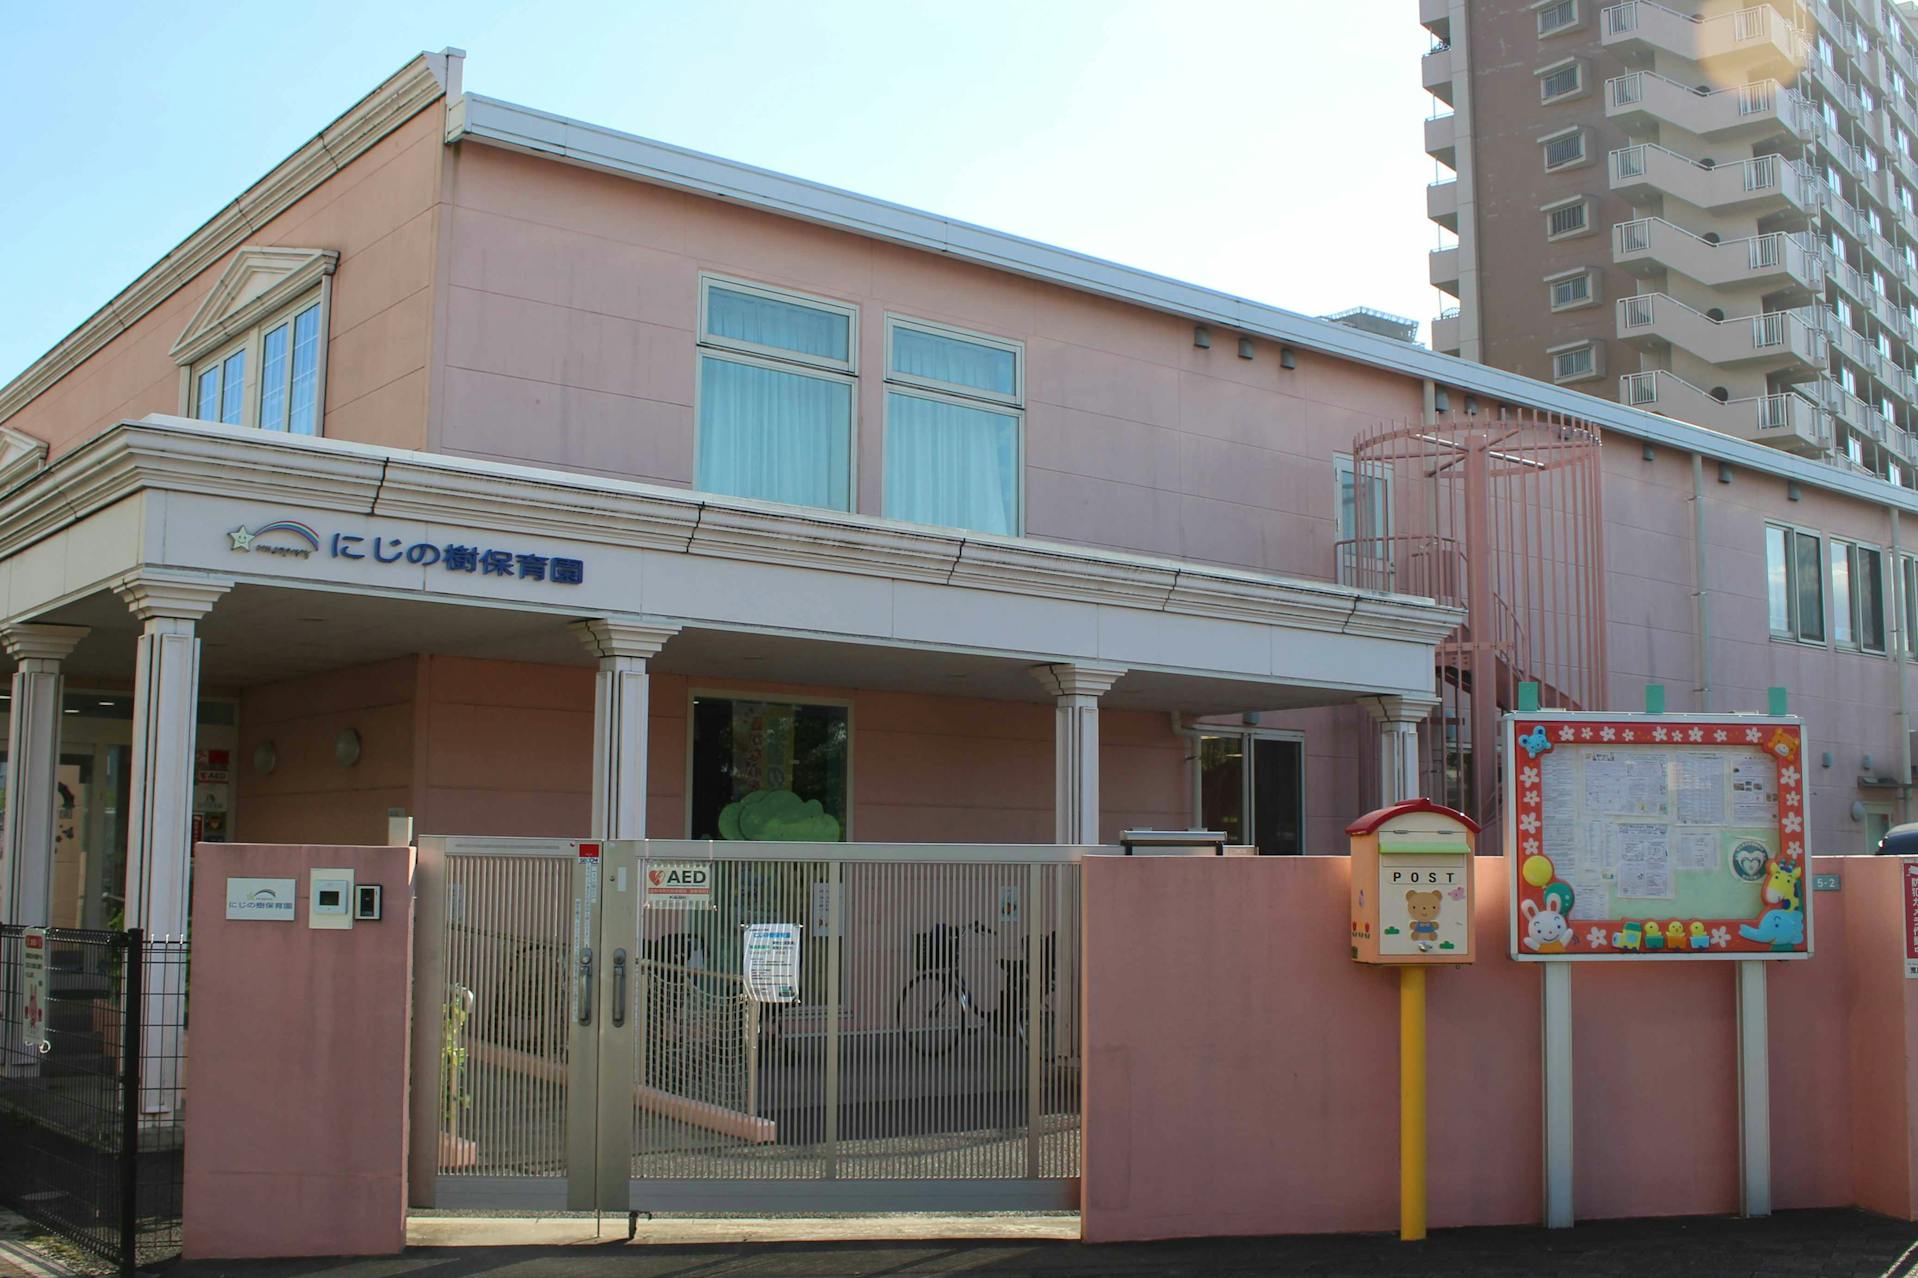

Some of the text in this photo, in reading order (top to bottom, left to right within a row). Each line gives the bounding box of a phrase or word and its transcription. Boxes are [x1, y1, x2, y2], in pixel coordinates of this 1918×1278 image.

[331, 533, 584, 585] にじの樹保育園
[667, 870, 706, 884] AED
[1393, 872, 1455, 883] POST
[1817, 878, 1836, 888] 5-2
